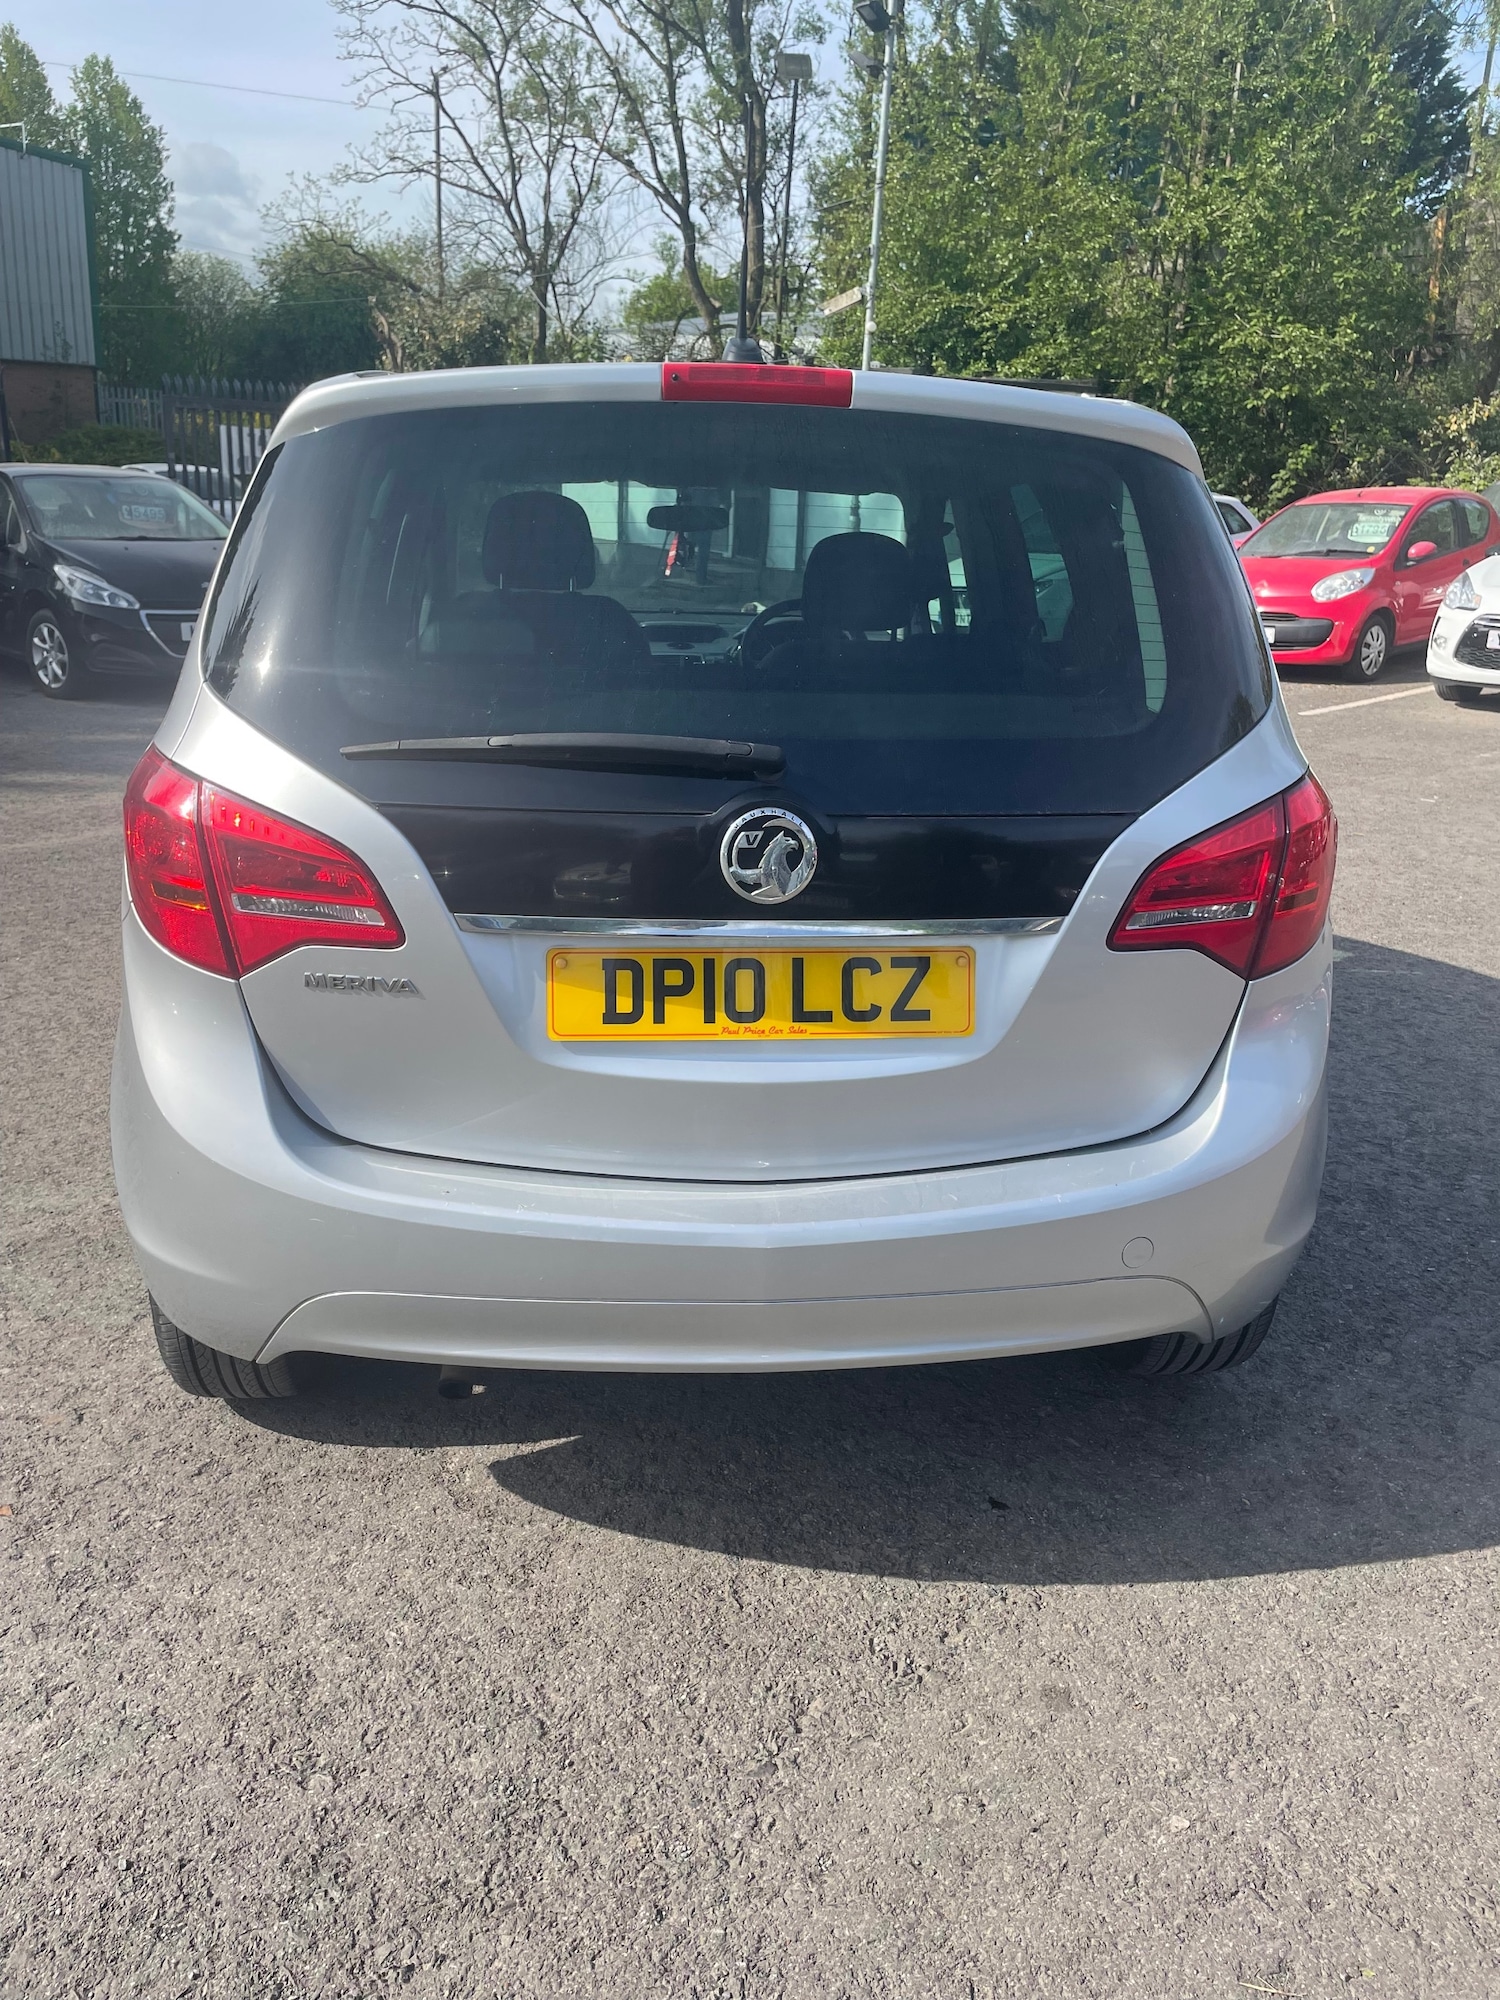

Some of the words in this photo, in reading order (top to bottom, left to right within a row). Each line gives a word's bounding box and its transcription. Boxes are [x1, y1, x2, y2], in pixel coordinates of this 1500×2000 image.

[734, 809, 803, 830] VAUXHALL
[303, 972, 420, 995] MERIVA
[601, 957, 766, 1024] DP10
[791, 956, 932, 1023] LCZ
[721, 1026, 740, 1035] Paul
[743, 1026, 766, 1035] Price
[768, 1026, 784, 1035] Car
[787, 1025, 808, 1034] Sales
